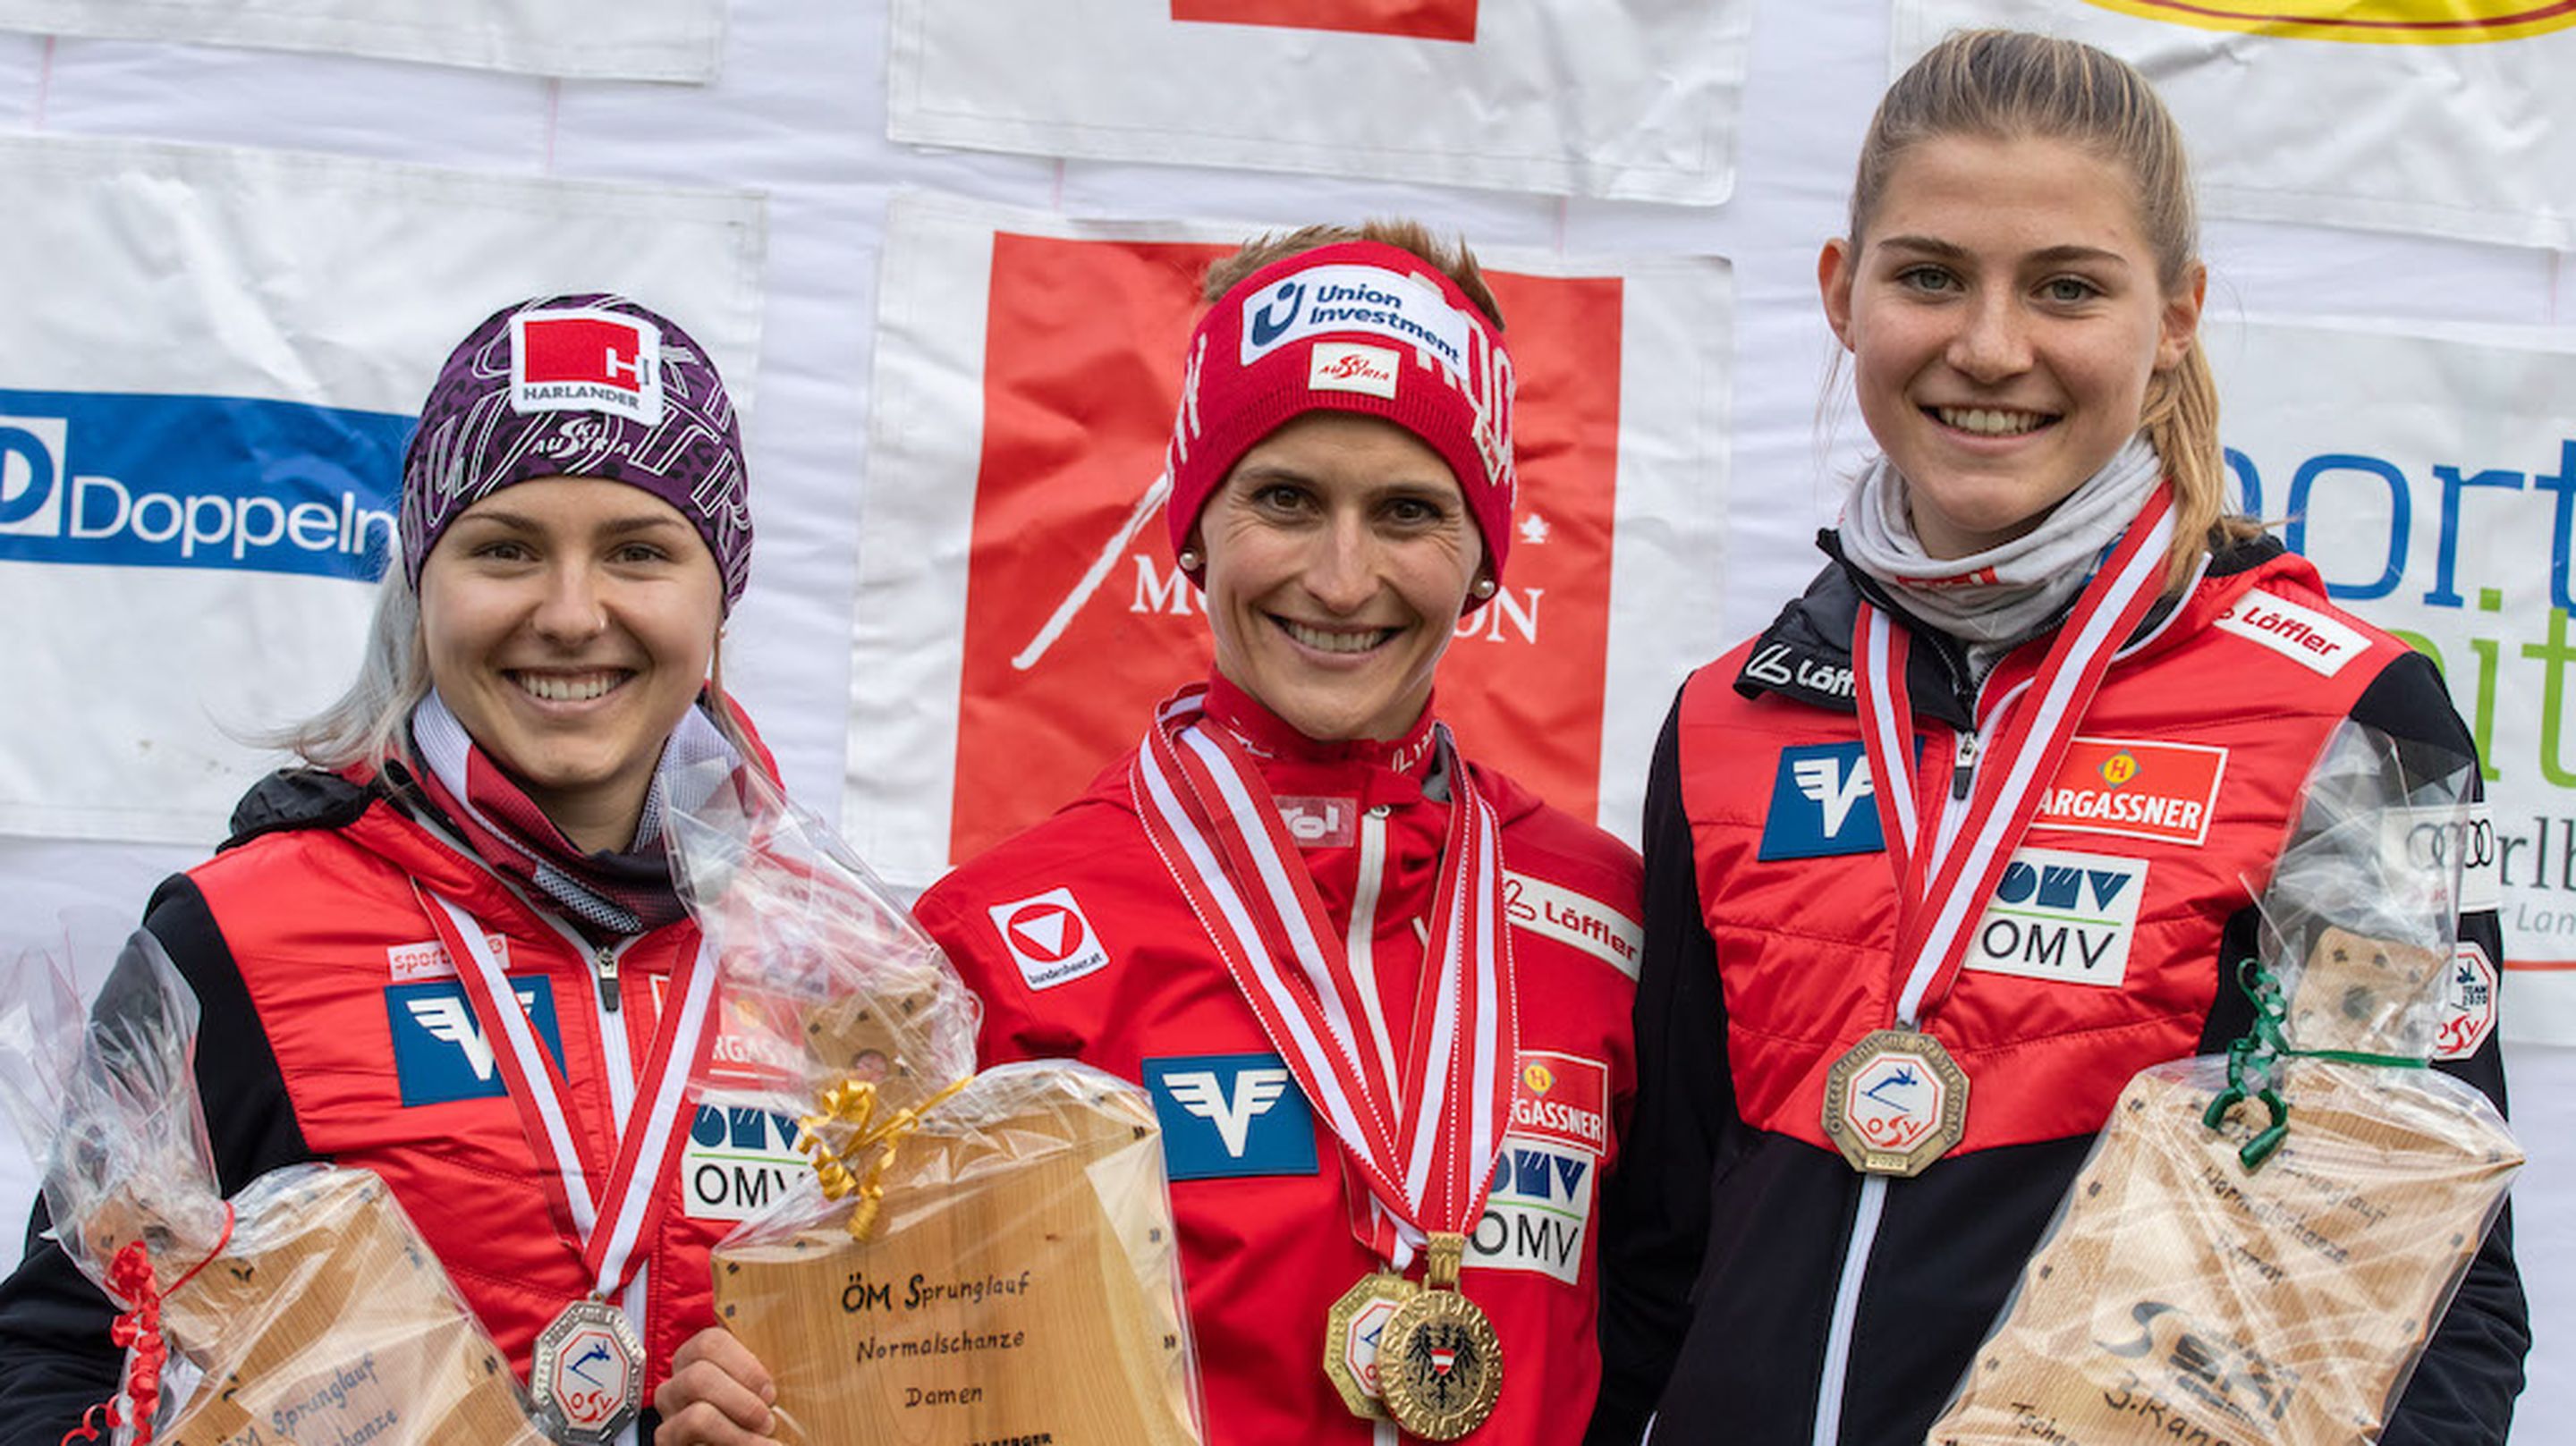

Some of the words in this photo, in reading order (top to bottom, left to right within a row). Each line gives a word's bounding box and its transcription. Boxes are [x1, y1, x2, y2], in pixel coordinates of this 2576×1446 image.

[1317, 283, 1402, 309] Union
[1309, 307, 1462, 366] Investment
[1318, 360, 1390, 381] AUSTRIA
[523, 385, 640, 410] HARLANDER
[2224, 439, 2576, 619] ort
[2241, 606, 2342, 655] Löffler
[1796, 659, 1857, 697] Löff
[2384, 587, 2576, 789] it
[1545, 901, 1638, 961] Löffler
[1981, 918, 2116, 969] OMV
[1471, 1210, 1579, 1267] OMV
[842, 1273, 893, 1314] ÖM
[903, 1271, 1031, 1310] Sprunglauf
[856, 1330, 1026, 1363] Normalschanze
[272, 1350, 378, 1436] Sprunglauf
[904, 1387, 984, 1408] Damen
